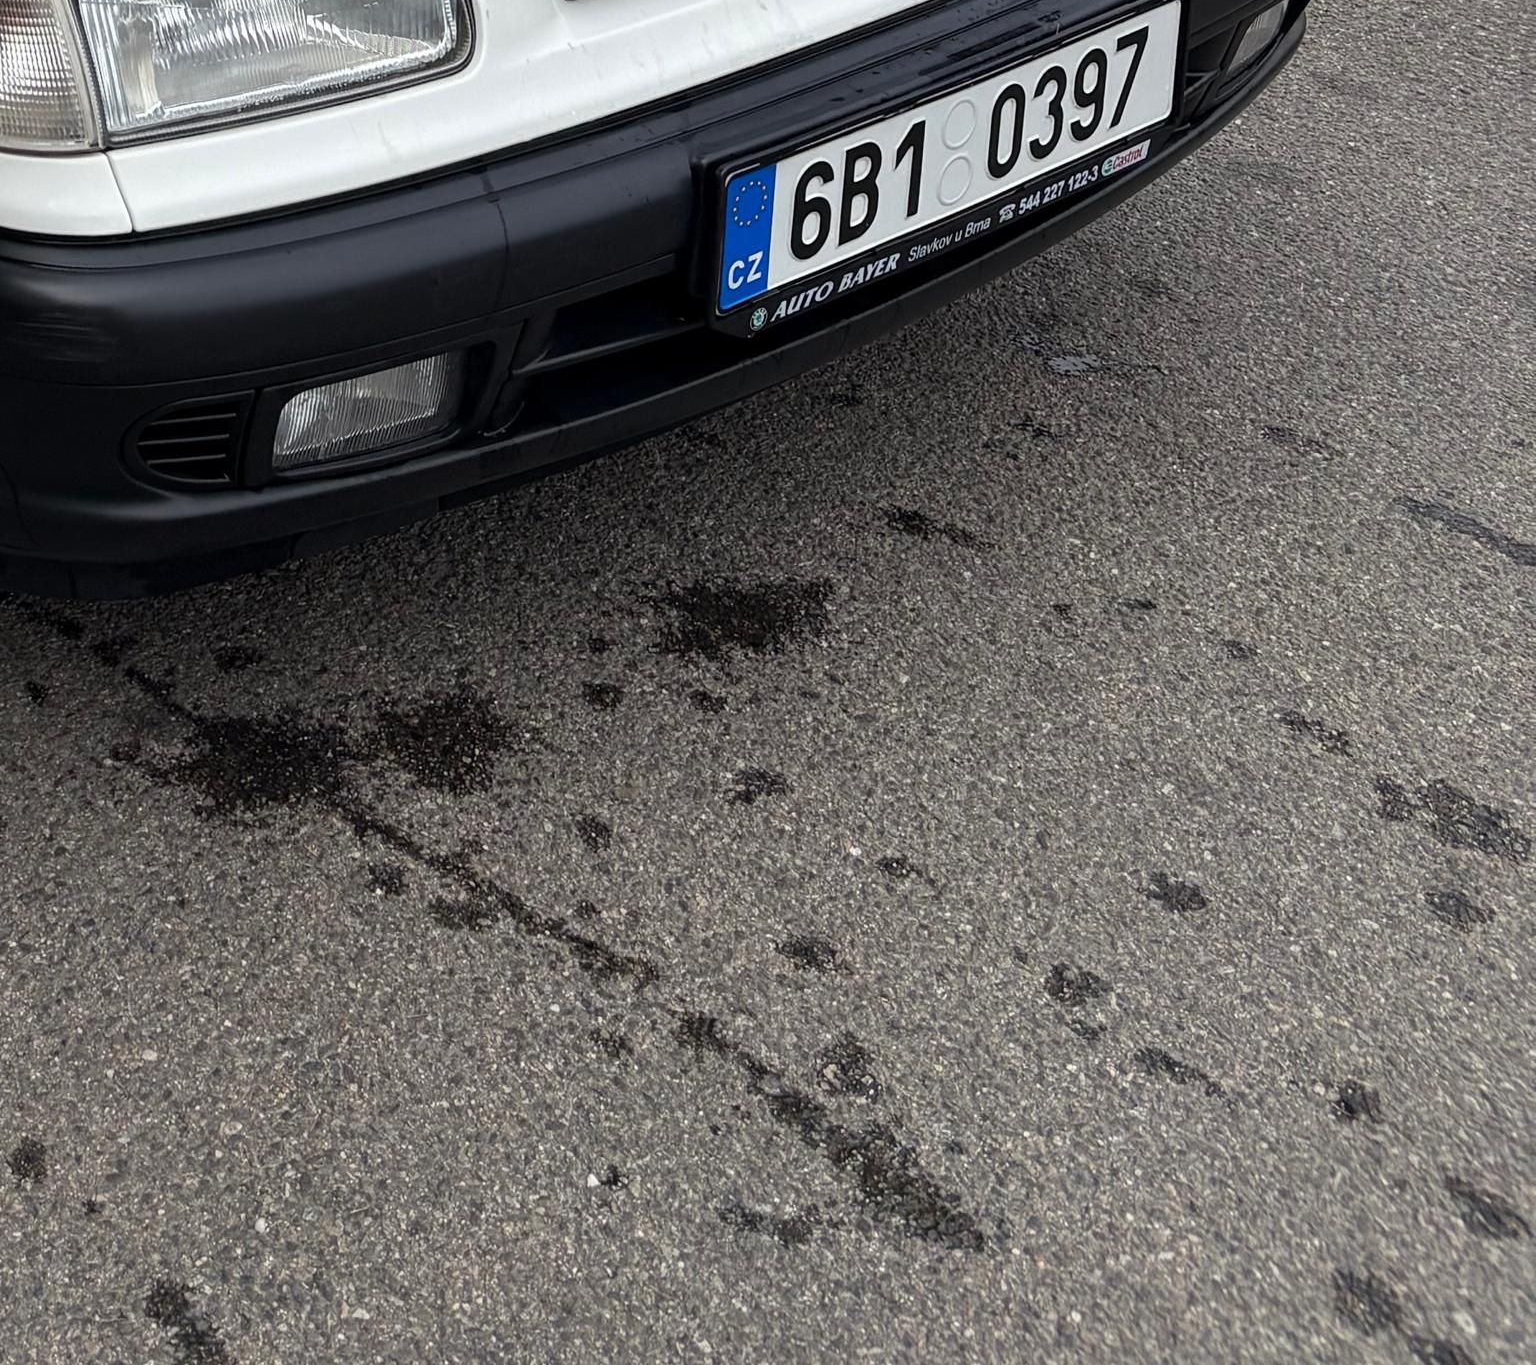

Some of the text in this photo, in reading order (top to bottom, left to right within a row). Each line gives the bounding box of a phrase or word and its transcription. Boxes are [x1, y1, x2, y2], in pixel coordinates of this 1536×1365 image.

[788, 25, 1150, 262] 6B1 0397
[1113, 145, 1145, 170] Castrol
[727, 250, 763, 290] CZ
[770, 280, 834, 322] AUTO
[837, 252, 901, 294] BAYER
[907, 233, 953, 263] Slavkov
[954, 229, 962, 242] u
[964, 216, 991, 238] Brna
[1018, 194, 1041, 215] 544
[1042, 180, 1065, 203] 227
[1067, 166, 1099, 192] 122-3
